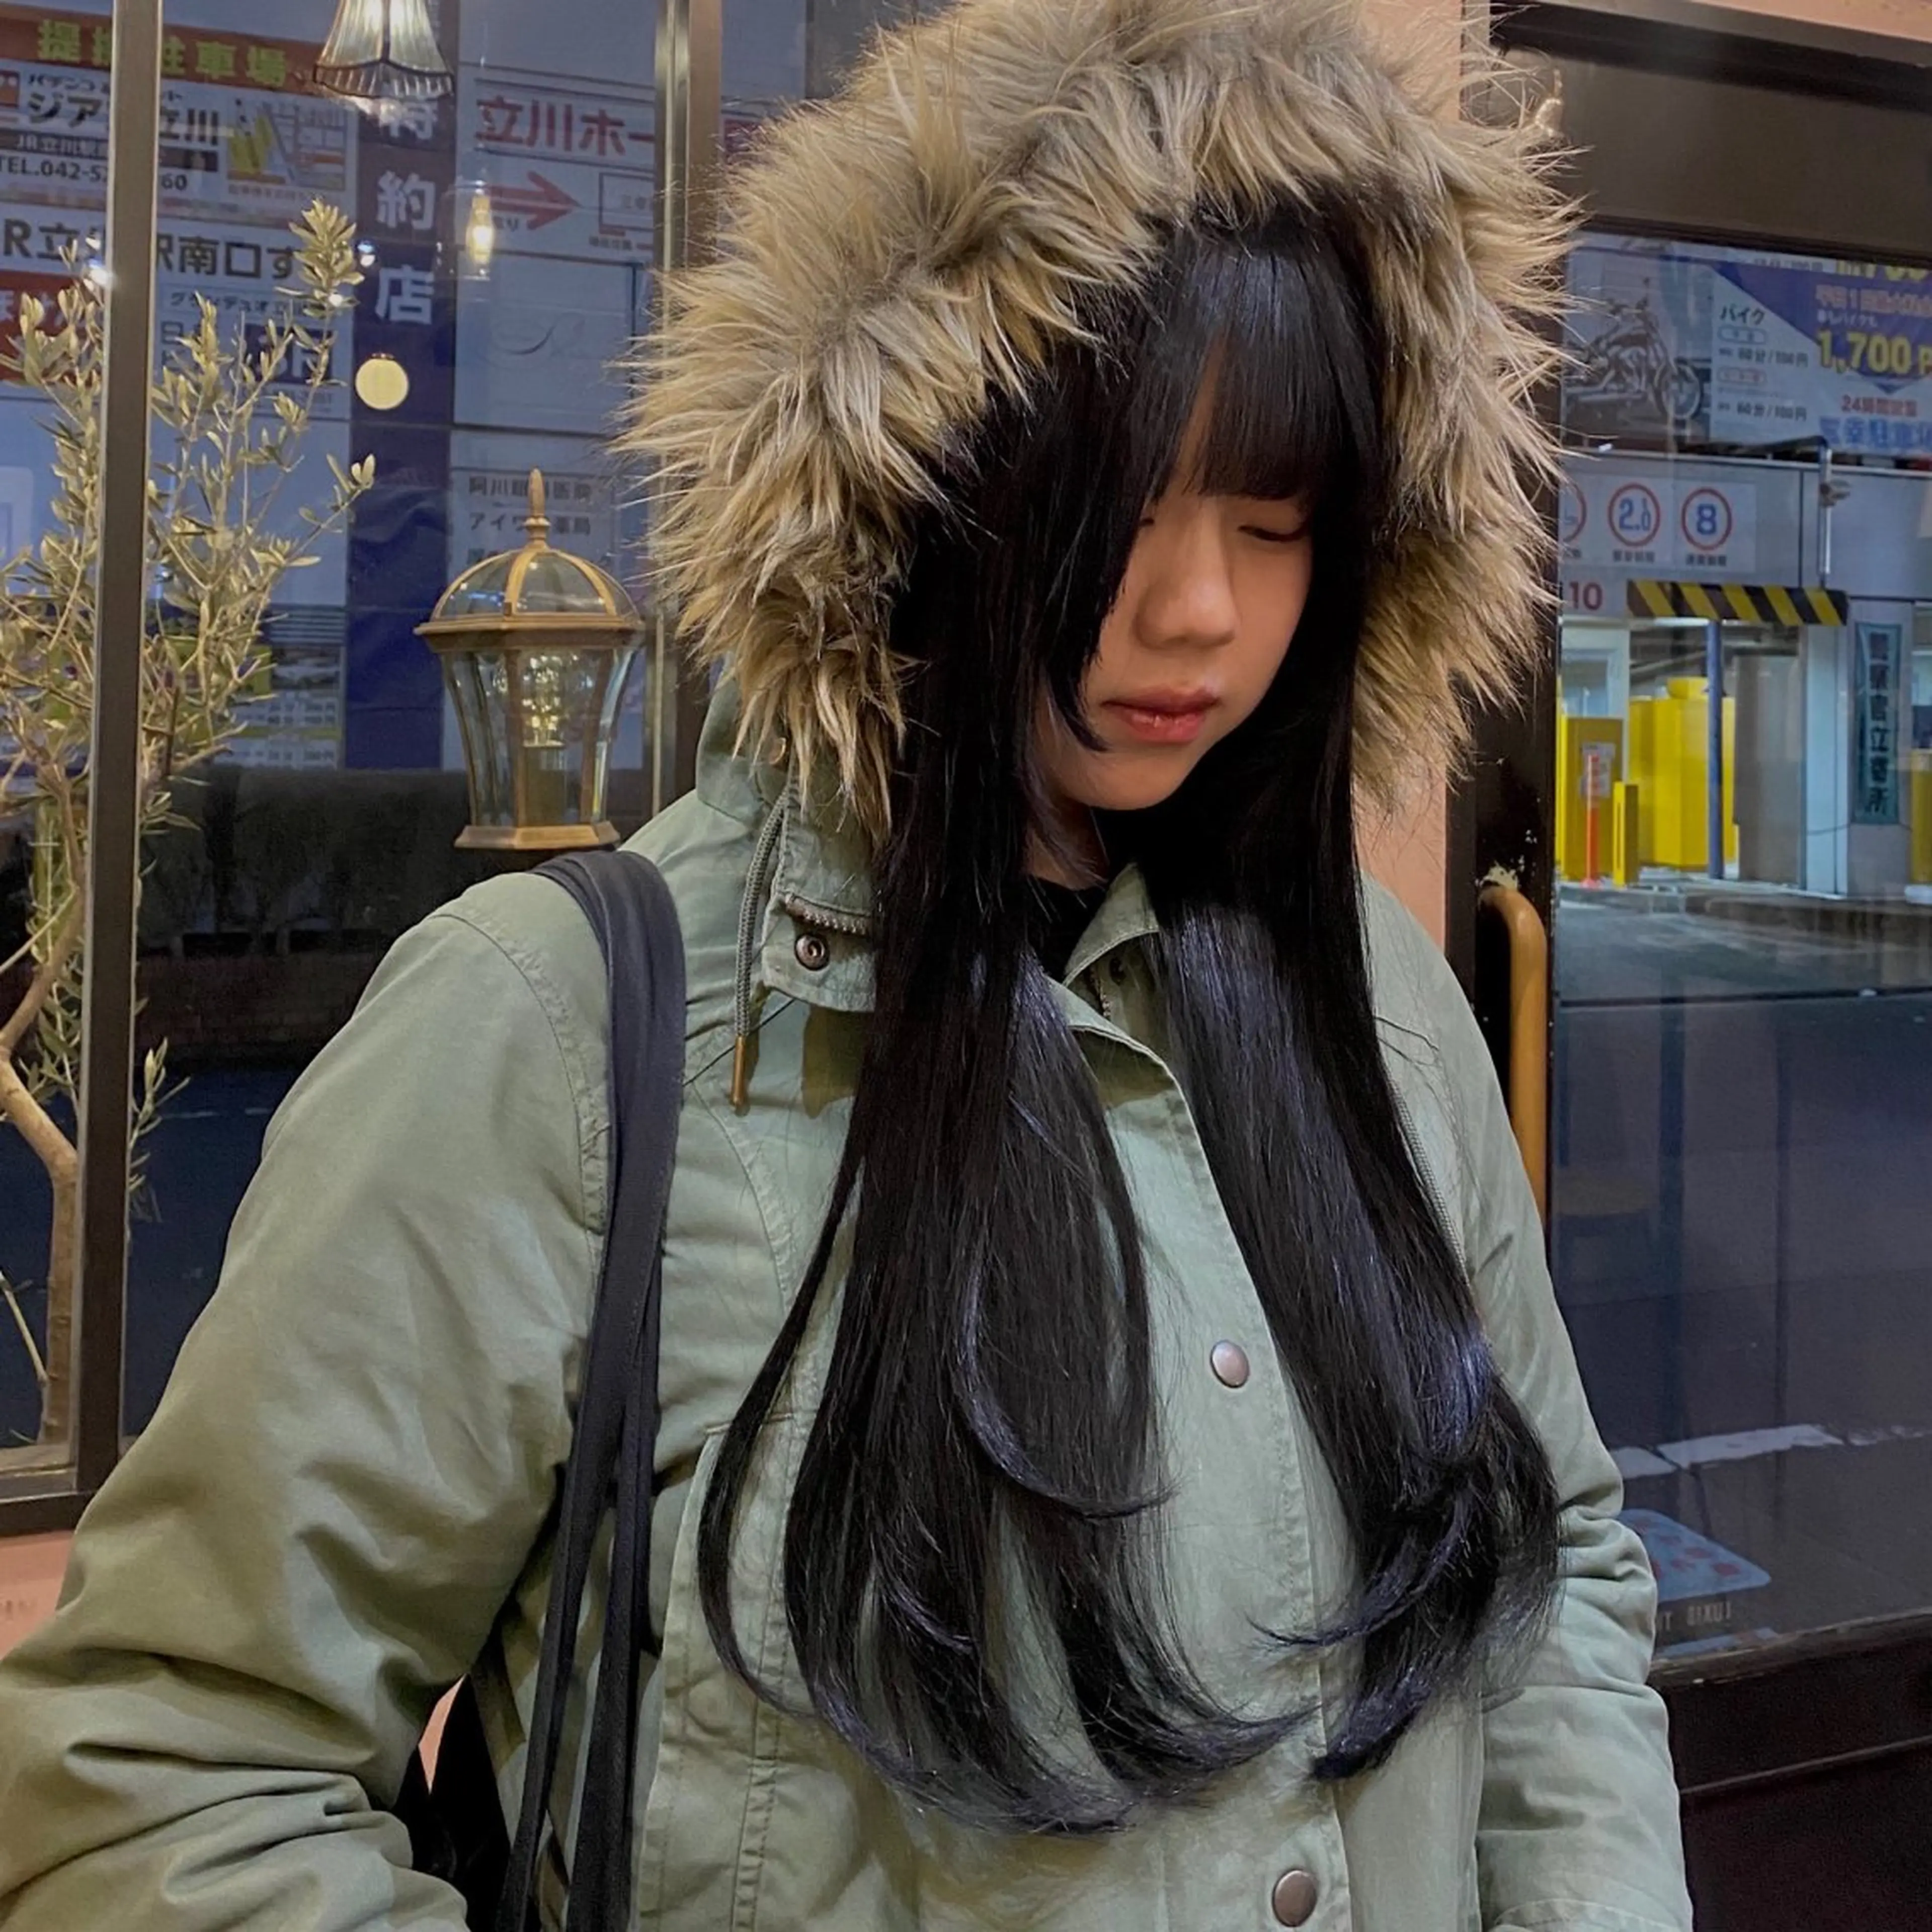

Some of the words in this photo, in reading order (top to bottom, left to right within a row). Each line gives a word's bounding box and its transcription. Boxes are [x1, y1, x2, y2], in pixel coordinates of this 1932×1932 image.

[1719, 303, 1765, 325] バイク
[1696, 504, 1717, 535] 8
